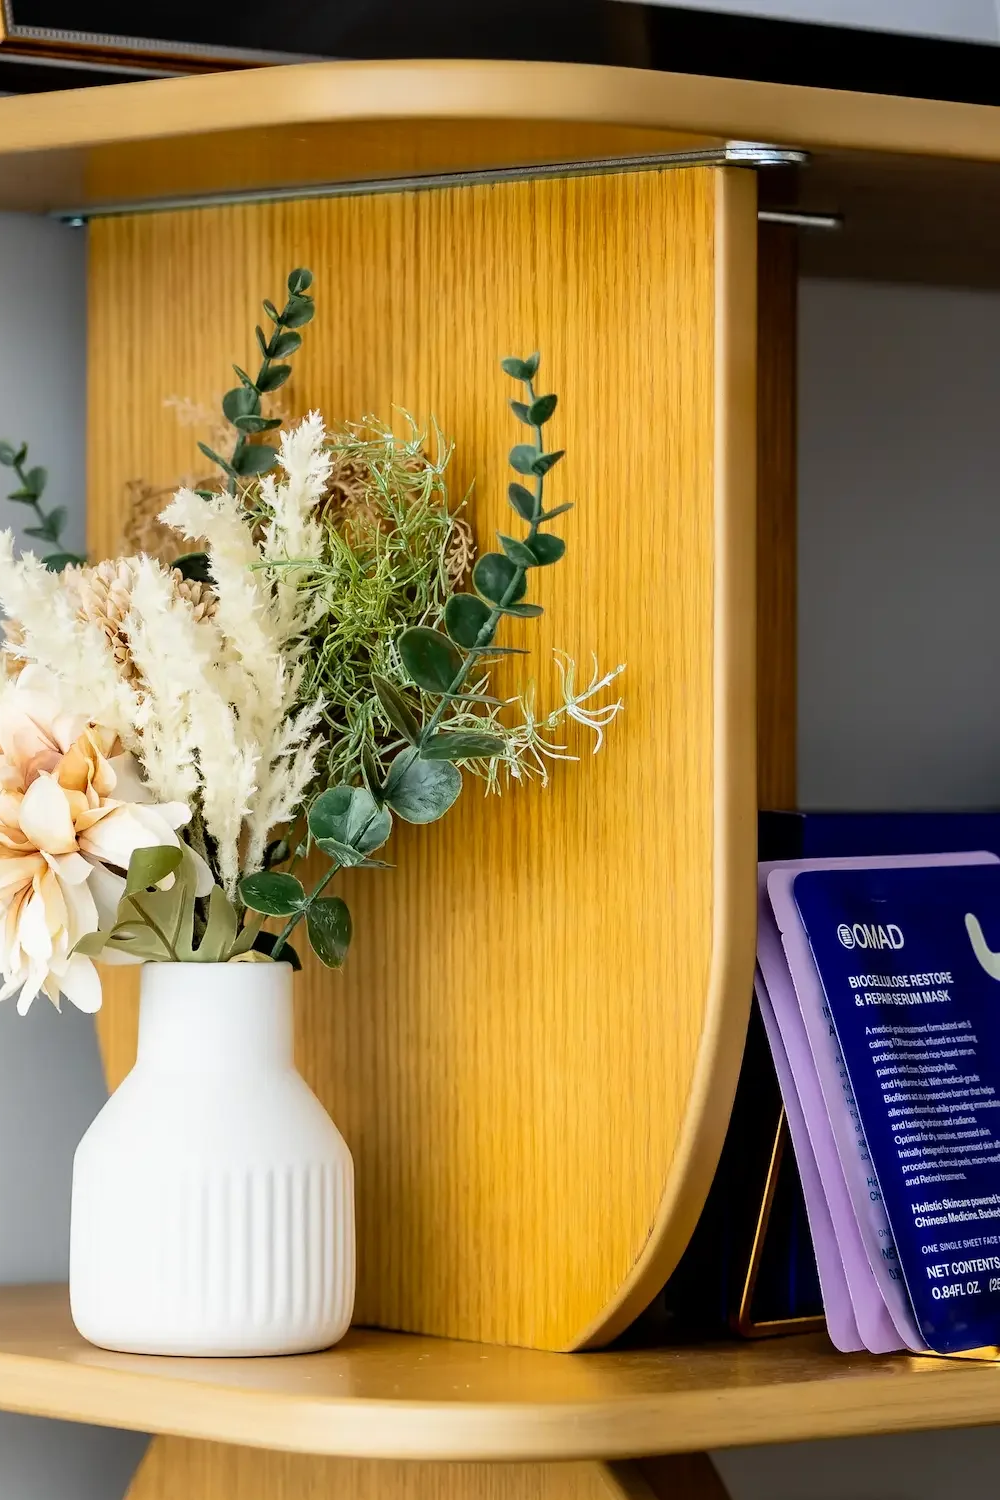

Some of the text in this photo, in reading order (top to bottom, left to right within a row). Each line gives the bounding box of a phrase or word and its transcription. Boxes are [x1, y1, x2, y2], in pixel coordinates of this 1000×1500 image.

[848, 972, 954, 989] BIOCELLULOSE RESTORE
[854, 990, 951, 1007] & REPAIR SERUM MASK
[865, 1027, 872, 1035] A
[927, 1022, 957, 1032] formulated
[868, 1038, 893, 1048] calming
[872, 1051, 899, 1064] probiotic
[876, 1065, 898, 1078] paired
[881, 1079, 894, 1089] and
[883, 1093, 911, 1103] Biofibers
[887, 1106, 914, 1117] alleviate
[891, 1121, 905, 1131] and
[905, 1119, 924, 1129] lasting
[894, 1133, 921, 1145] Optimal
[957, 1128, 979, 1138] stressed
[897, 1147, 922, 1158] Initially
[949, 1142, 983, 1154] compromised
[982, 1140, 994, 1149] skin
[905, 1175, 920, 1186] and
[919, 1174, 941, 1184] Retinol
[911, 1200, 943, 1214] Holistic
[942, 1198, 971, 1209] Skincare
[971, 1194, 996, 1208] powered
[915, 1215, 948, 1228] Chinese
[947, 1211, 980, 1223] Medicine.
[921, 1235, 998, 1254] ONE SINGLE SHEET FACE
[926, 1256, 1000, 1279] NET CONTENTS
[931, 1283, 966, 1300] 0.84FL
[966, 1281, 981, 1295] OZ.
